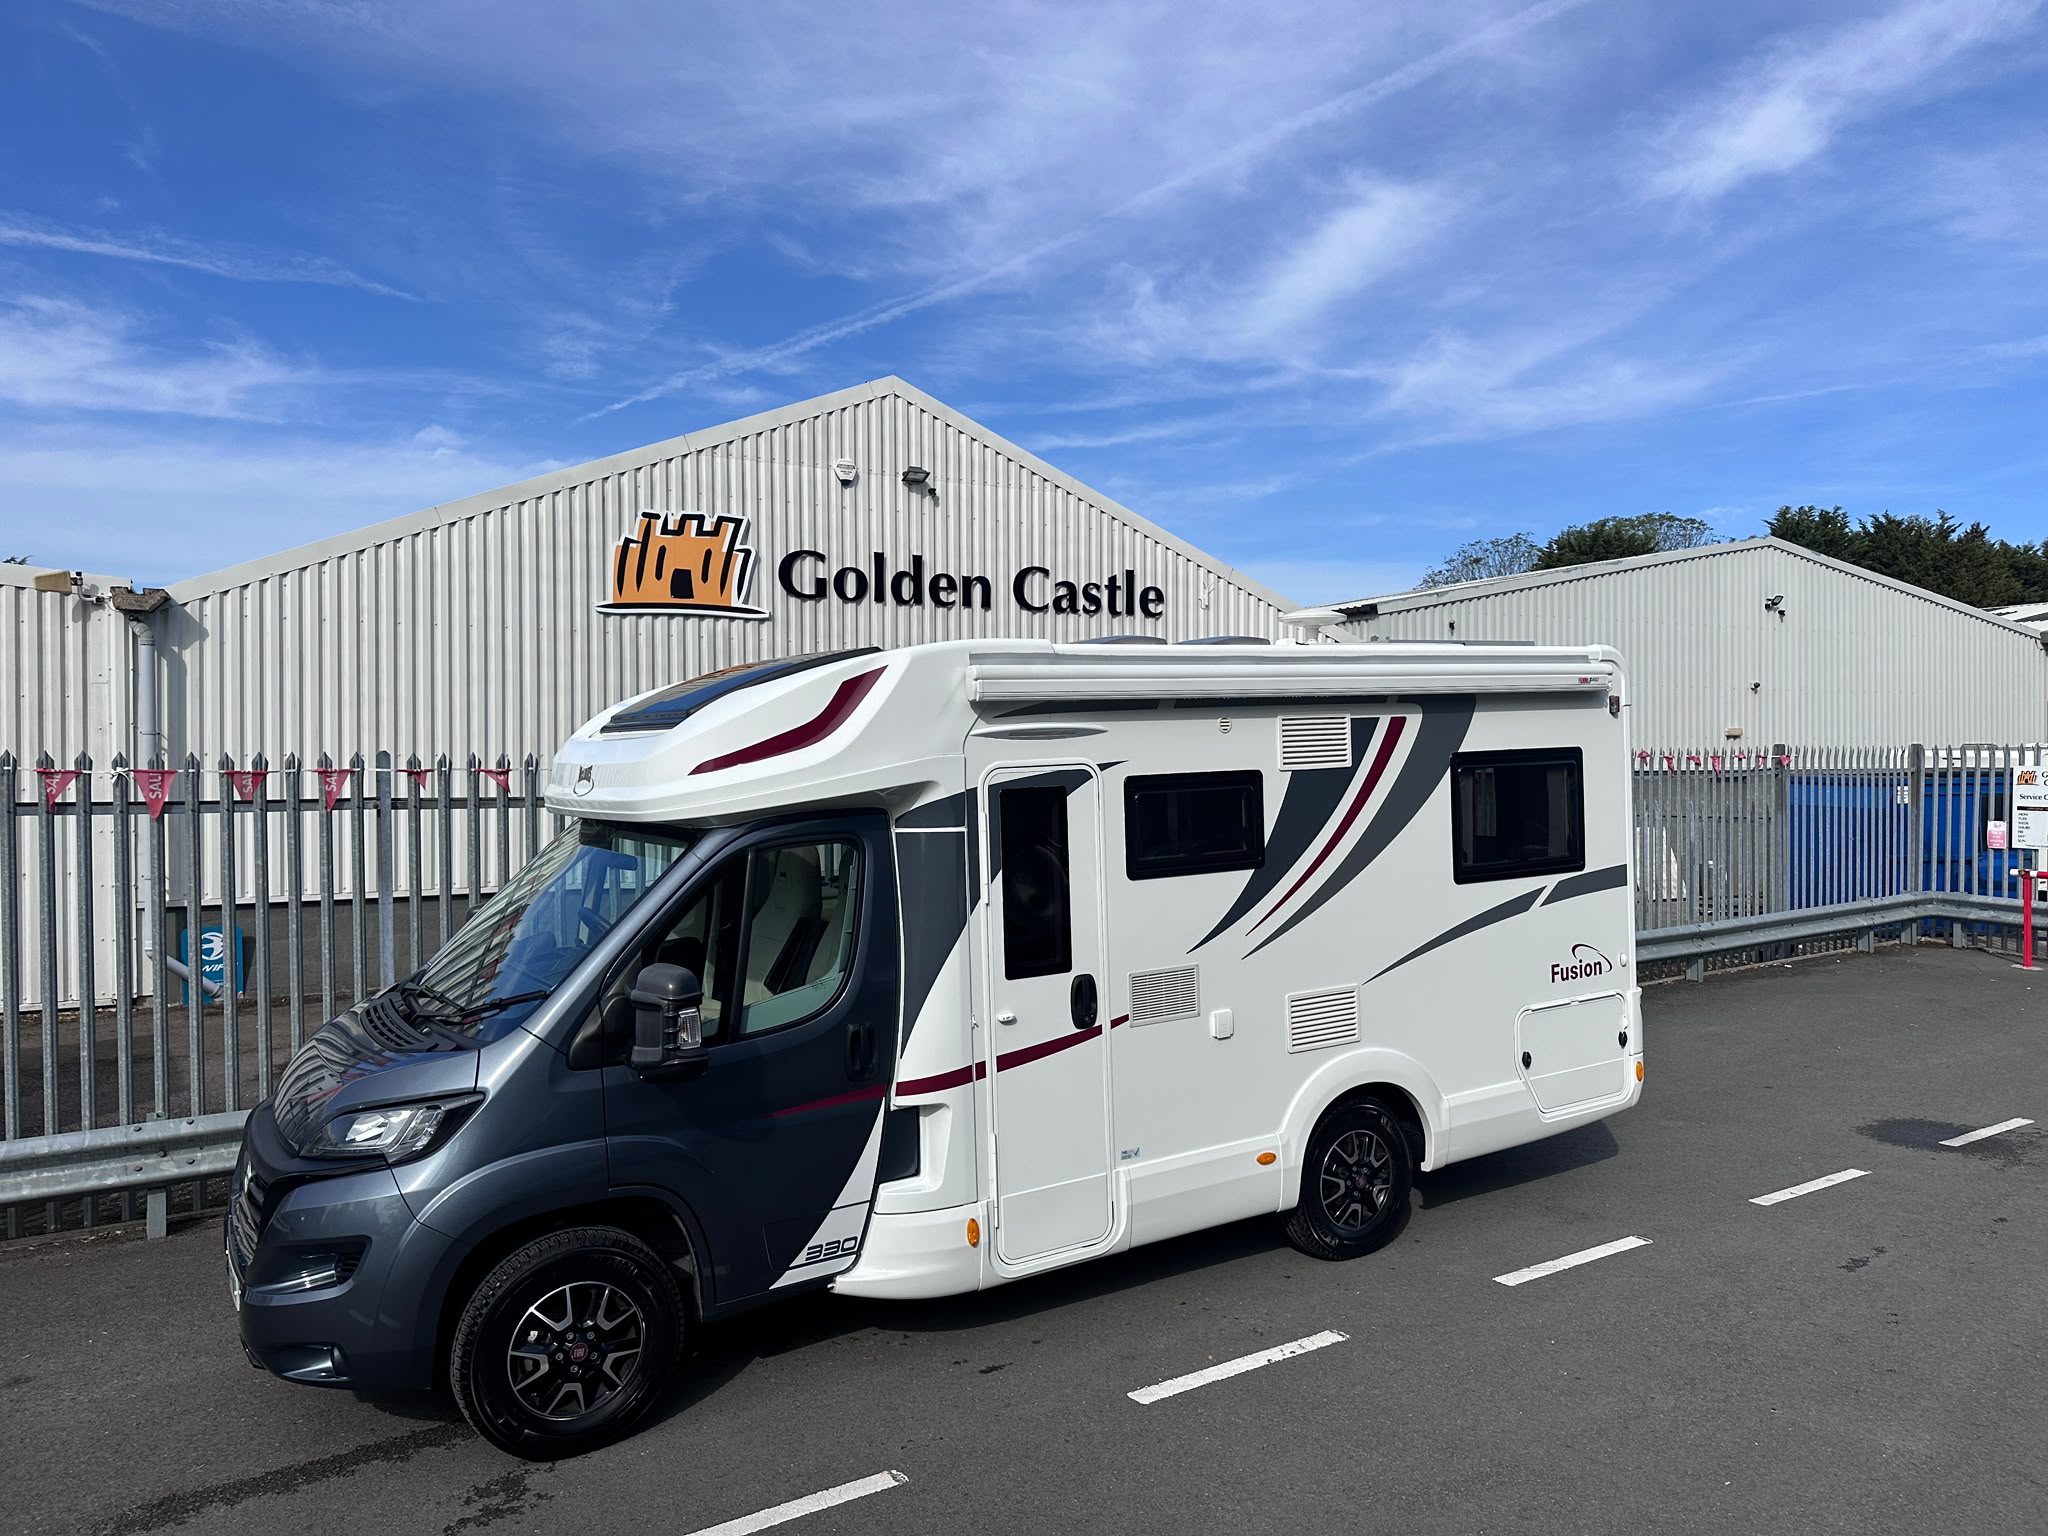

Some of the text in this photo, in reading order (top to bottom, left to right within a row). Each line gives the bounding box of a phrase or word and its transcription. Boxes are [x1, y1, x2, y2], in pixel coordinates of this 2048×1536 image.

[778, 549, 1165, 619] Golden Castle
[242, 770, 253, 793] SAL
[1551, 959, 1603, 983] Fusion
[805, 1236, 858, 1261] 330
